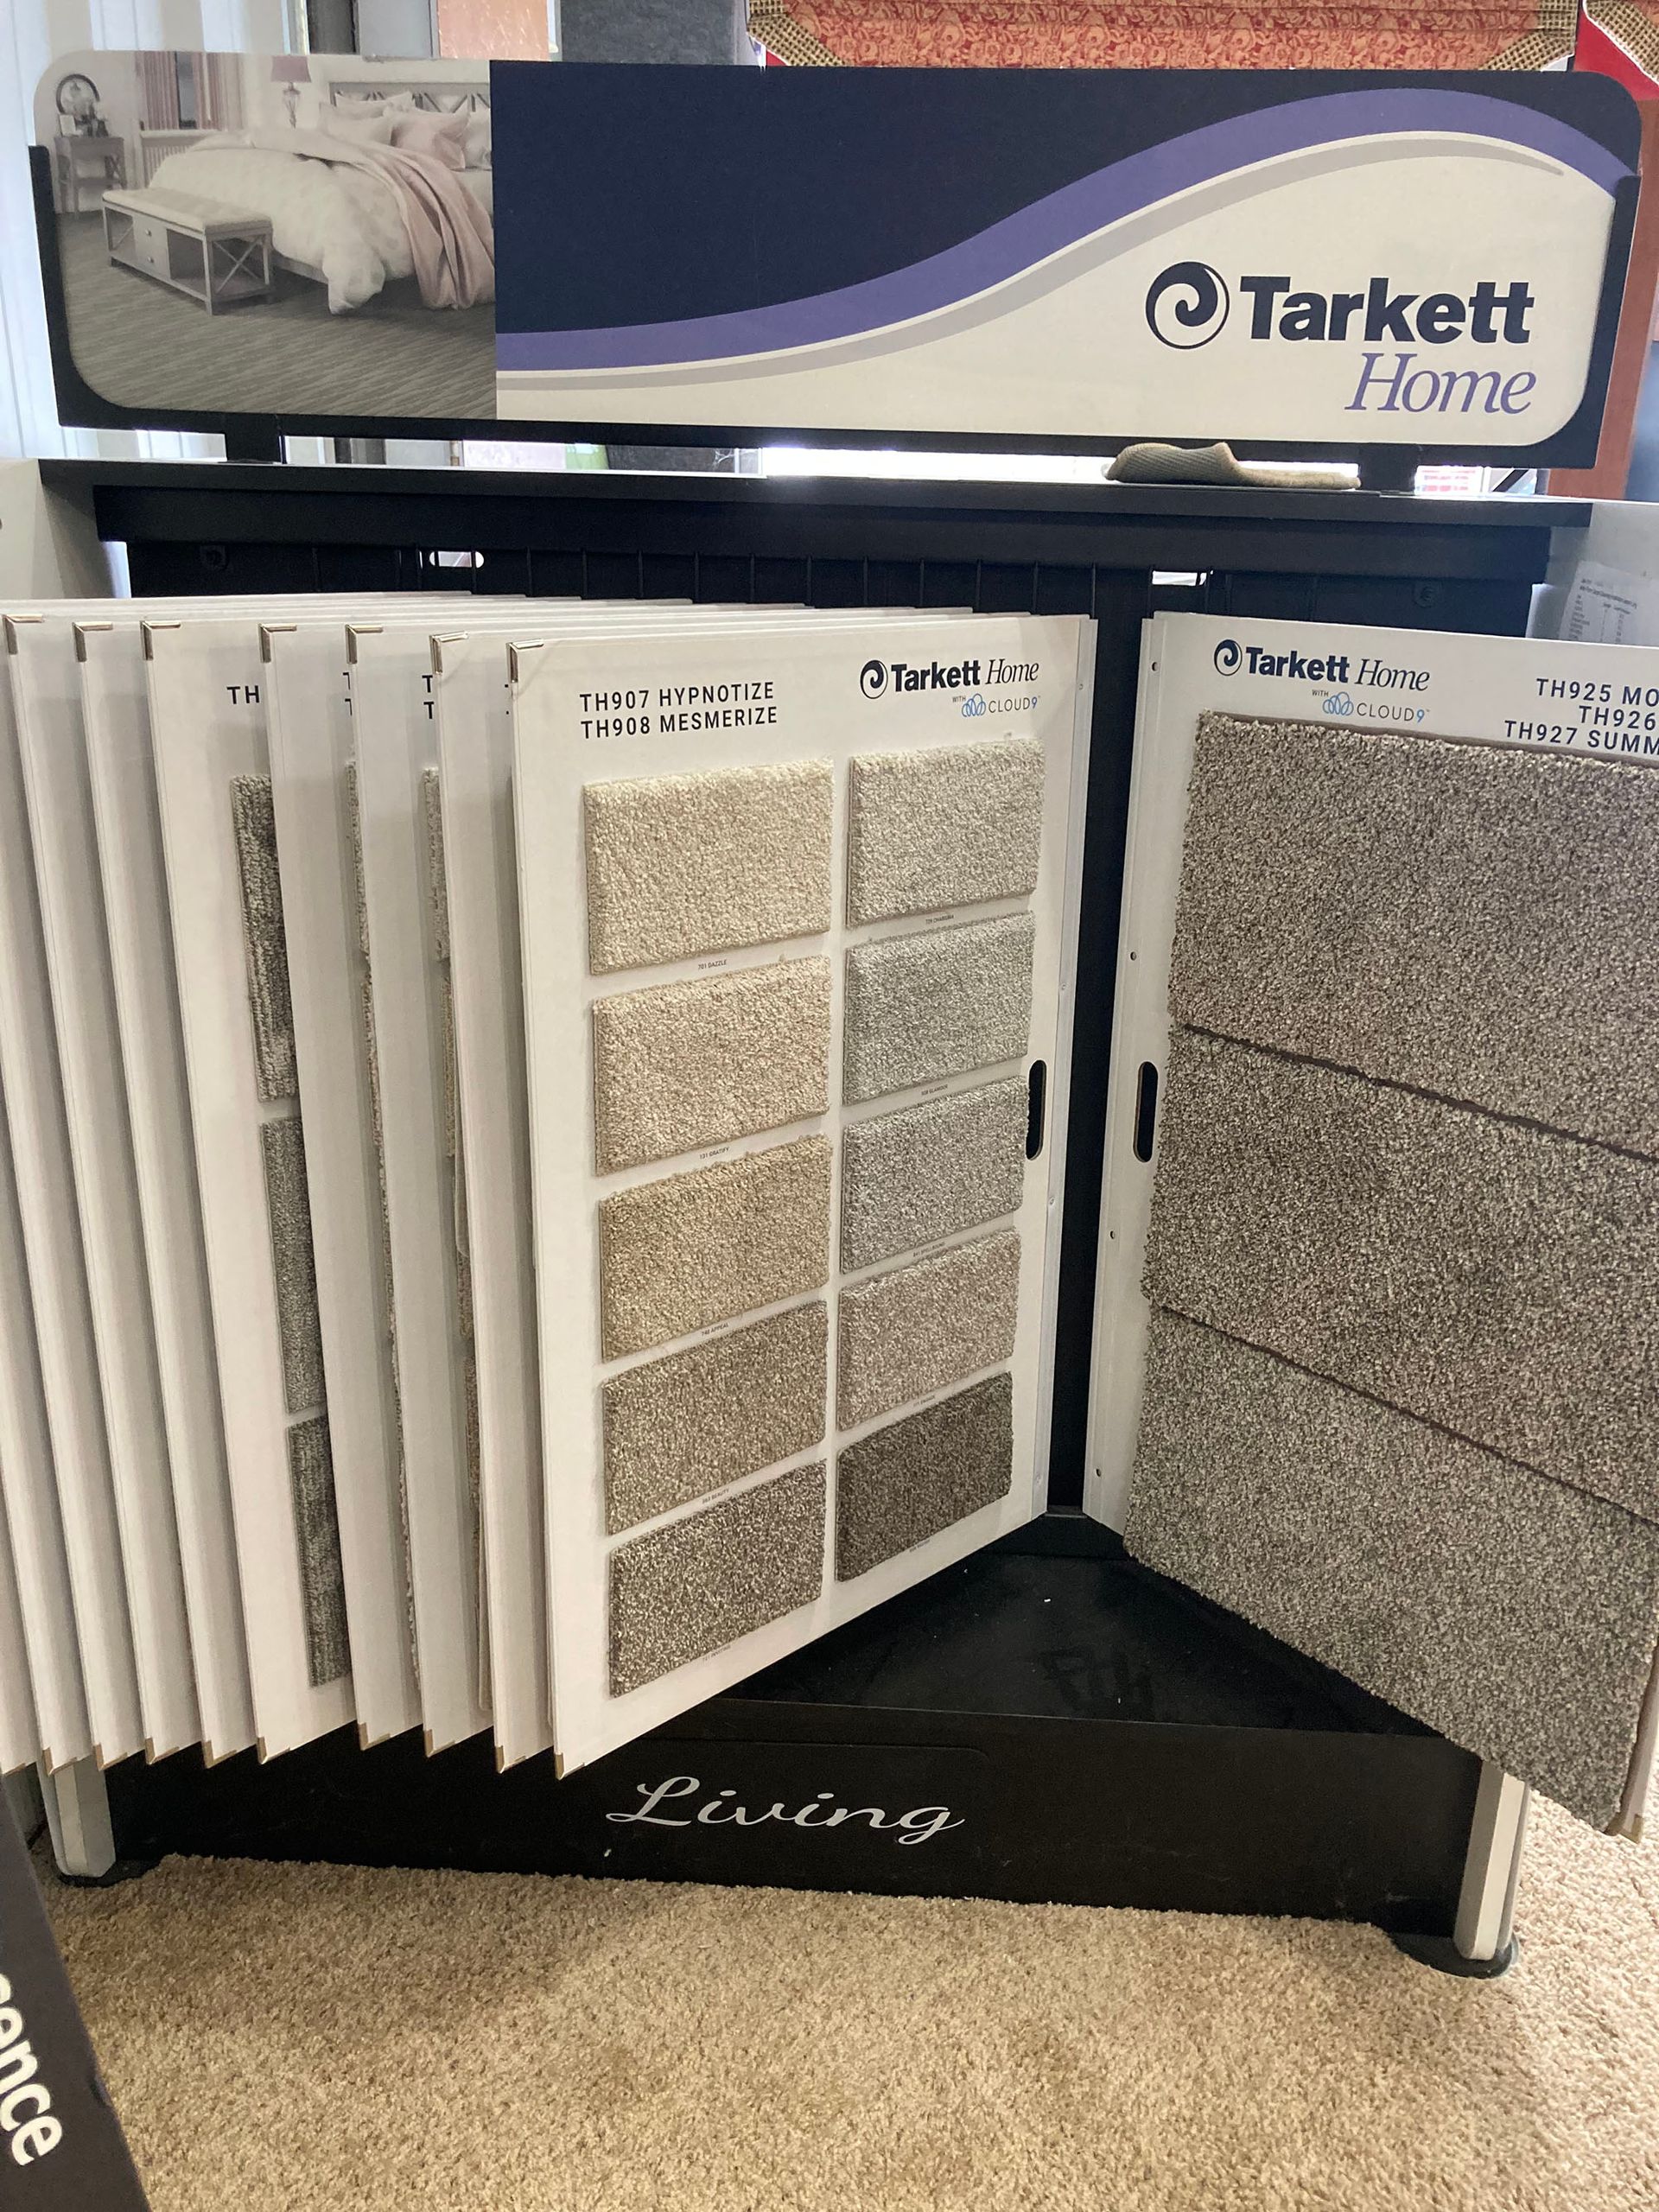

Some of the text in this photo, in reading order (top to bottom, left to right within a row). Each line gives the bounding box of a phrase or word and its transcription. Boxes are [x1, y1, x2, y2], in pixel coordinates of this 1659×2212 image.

[1240, 276, 1535, 344] Tarkett
[1344, 353, 1537, 415] Home
[891, 658, 1039, 692] Tarkett Home
[1246, 646, 1431, 691] Tarkett Home
[580, 682, 773, 712] TH907 HYPNOTIZE
[952, 695, 966, 703] WITH
[1312, 689, 1329, 697] WITH
[1536, 678, 1659, 708] TH925 MO
[581, 706, 778, 739] TH908 MESMERIZE
[1579, 705, 1656, 731] TH926
[1504, 719, 1659, 755] TH927 SUMM
[708, 959, 727, 969] DAZZLE
[605, 1776, 966, 1845] Living
